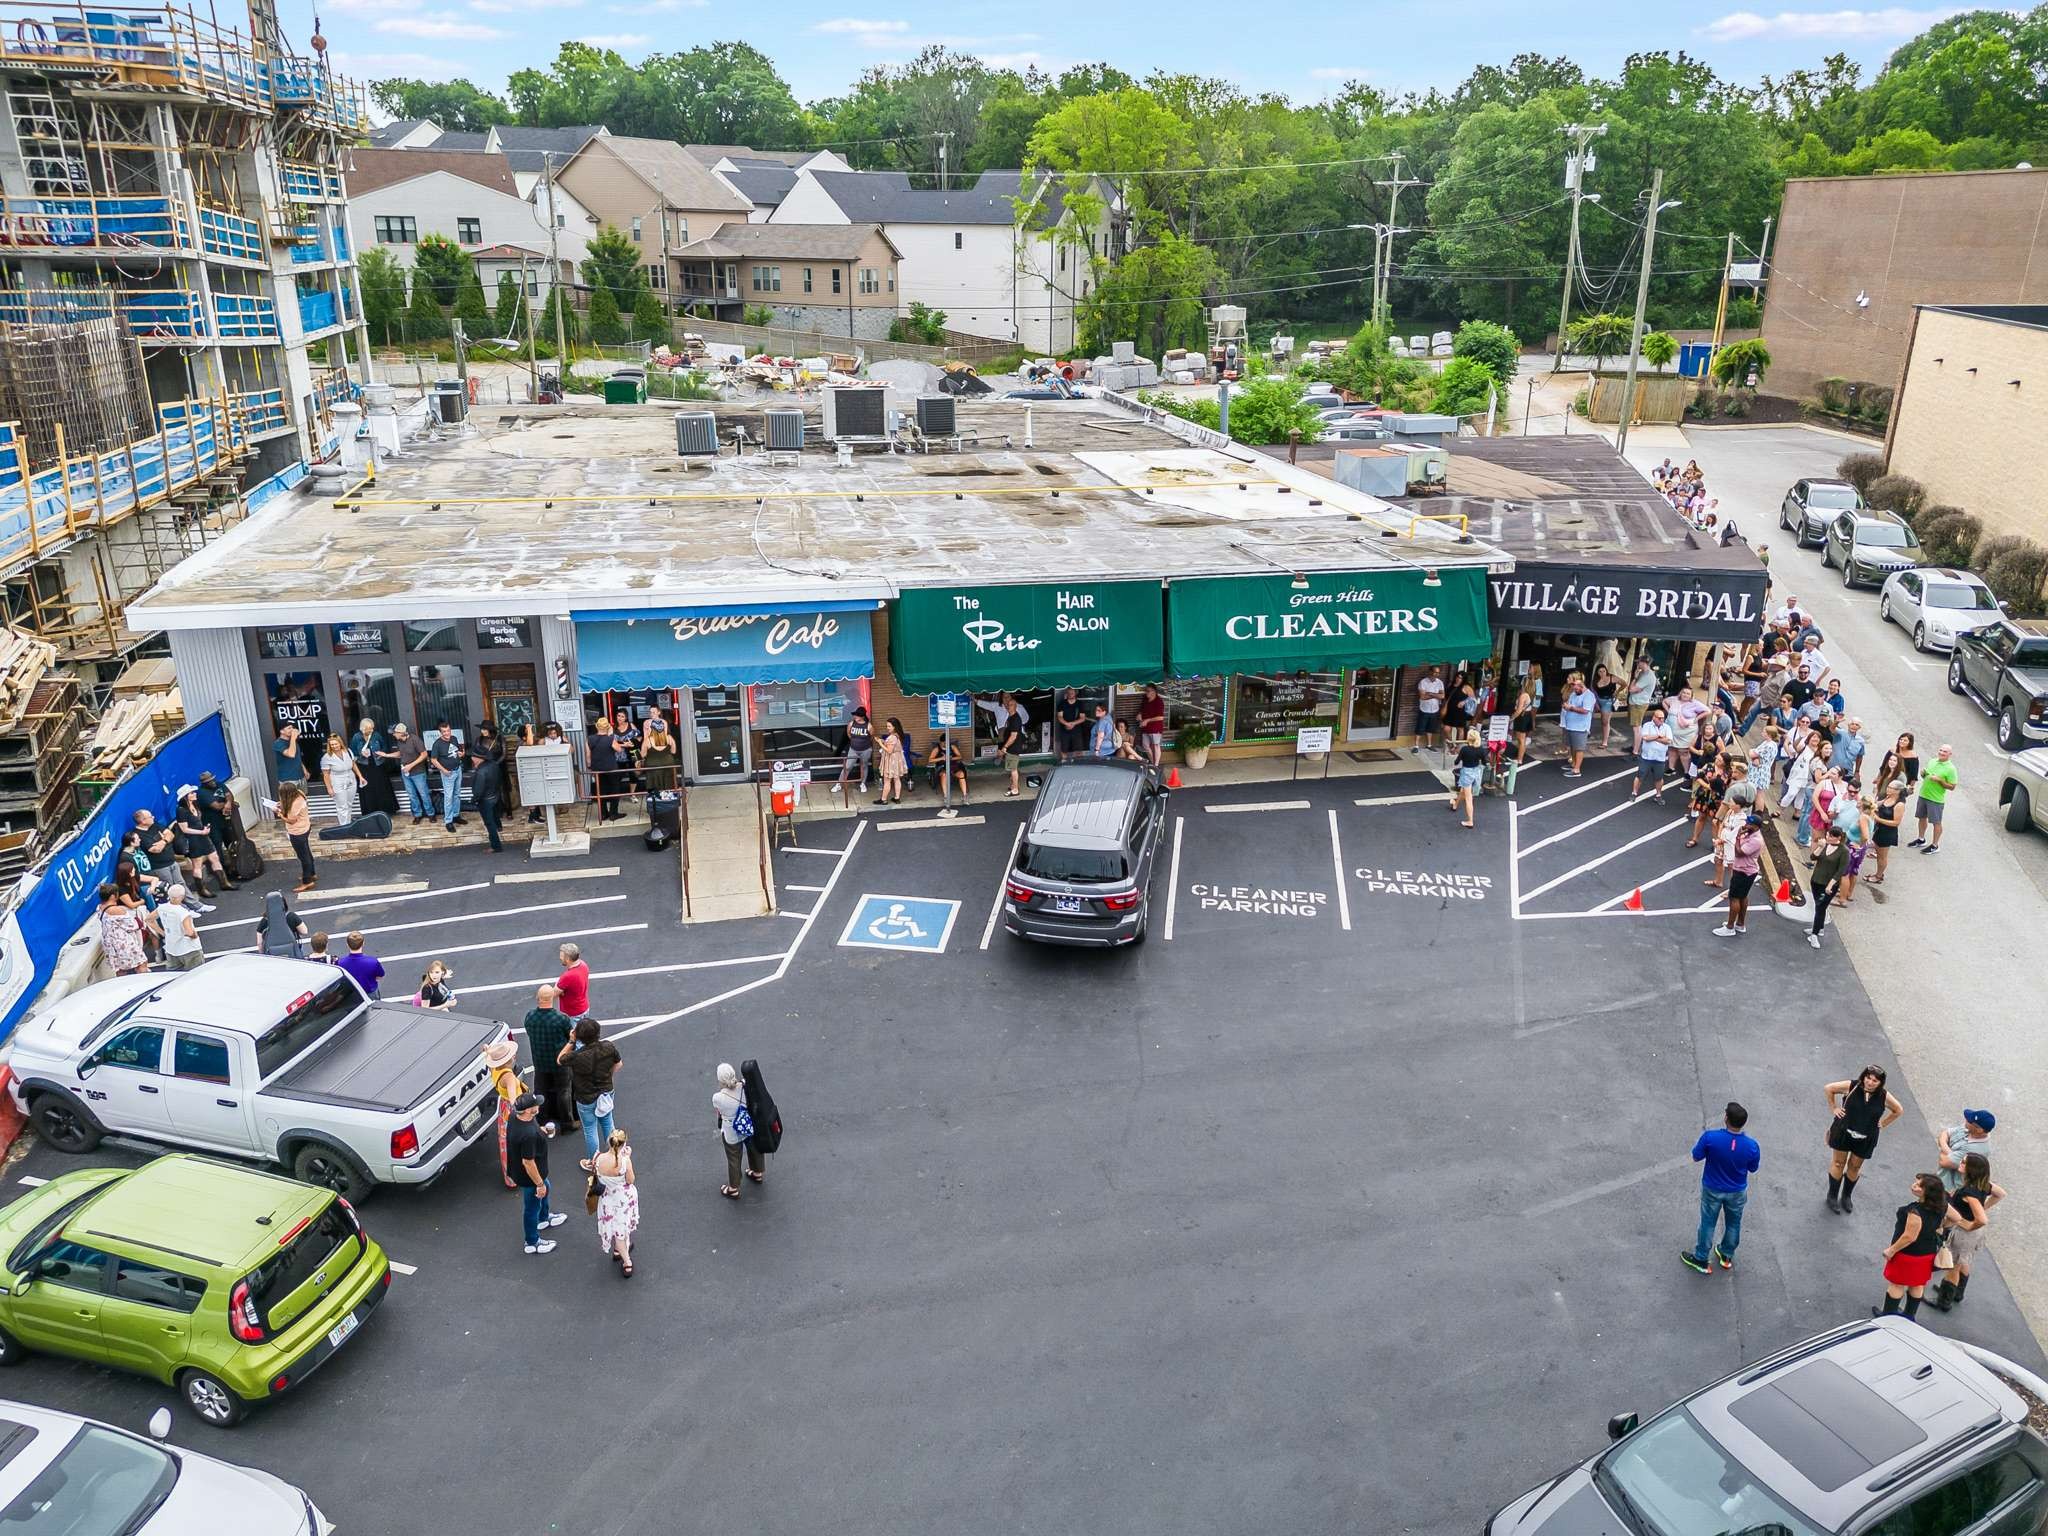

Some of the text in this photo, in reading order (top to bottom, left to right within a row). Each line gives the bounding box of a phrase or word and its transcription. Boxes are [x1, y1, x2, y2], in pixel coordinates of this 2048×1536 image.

[953, 596, 980, 610] The
[1289, 589, 1375, 608] Green Hills
[1490, 581, 1756, 622] VILLAGE BRIDAL
[480, 616, 525, 626] Green Hills
[1225, 607, 1439, 640] CLEANERS
[266, 631, 307, 642] BLUSHED
[489, 627, 518, 635] Barber
[494, 636, 515, 645] Shop
[765, 613, 840, 655] Cafe
[962, 612, 1042, 653] Patio
[277, 704, 322, 720] BUMP
[1255, 711, 1281, 720] Closets
[287, 719, 320, 734] ITY
[1355, 867, 1493, 888] CLEANER
[1191, 884, 1328, 905] CLEANER
[1368, 881, 1486, 900] PARKING
[1201, 898, 1317, 917] PARKING
[438, 1064, 489, 1118] RAM
